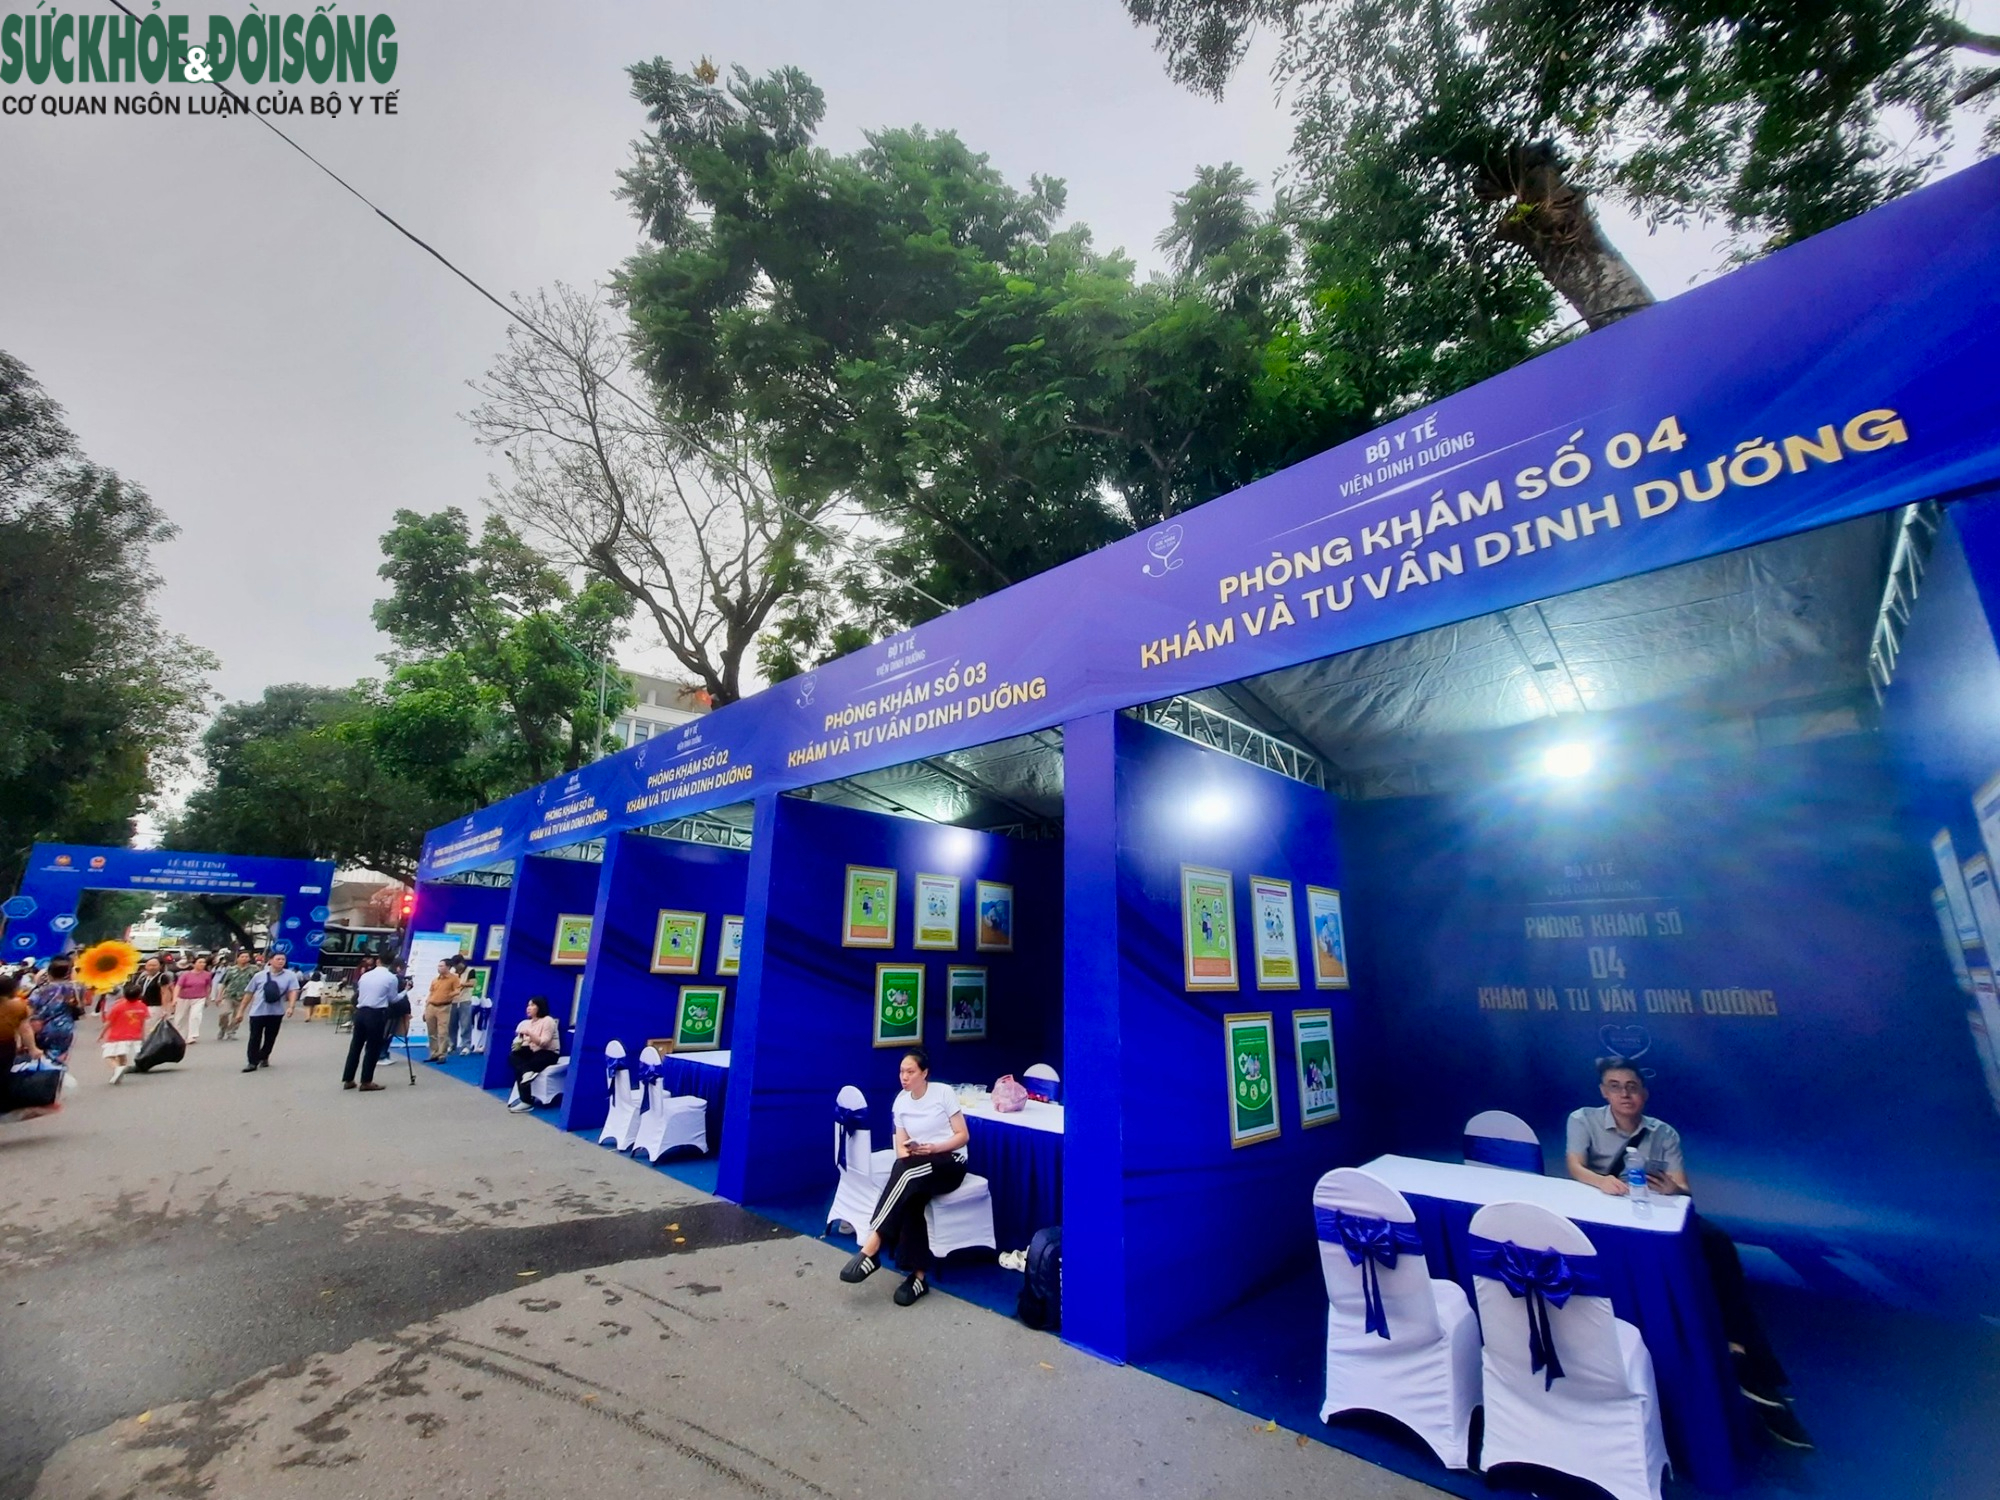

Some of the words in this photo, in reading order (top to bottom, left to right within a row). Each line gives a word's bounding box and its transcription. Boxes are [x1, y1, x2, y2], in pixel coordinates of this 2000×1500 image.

[1366, 437, 1391, 464] BỘ
[1394, 431, 1407, 451] Y
[1411, 411, 1438, 444] TẾ
[1339, 472, 1374, 498] VIỆN
[1377, 454, 1415, 484] DINH
[1418, 431, 1476, 467] DƯỠNG
[1219, 537, 1353, 604] PHÒNG
[1361, 479, 1505, 556] KHÁM
[1515, 428, 1592, 501] SỐ
[1605, 415, 1687, 469] 04
[1140, 617, 1235, 669] KHÁM
[1241, 594, 1295, 637] VÀ
[1301, 576, 1355, 619] TƯ
[1361, 536, 1465, 600] VẤN
[1474, 494, 1622, 568] DINH
[1633, 408, 1909, 520] DƯỠNG
[825, 701, 877, 732] PHÒNG
[880, 682, 930, 715] KHÁM
[934, 659, 960, 697] SỐ
[963, 661, 987, 688] 03
[787, 740, 828, 768] KHÁM
[830, 730, 850, 756] VÀ
[853, 726, 875, 750] TƯ
[876, 709, 912, 743] VẤN
[914, 701, 963, 733] DINH
[967, 677, 1046, 719] DƯỠNG
[626, 794, 648, 814] KHÁM
[649, 789, 659, 807] VÀ
[690, 775, 714, 795] DINH
[714, 764, 753, 789] DƯỠNG
[647, 769, 675, 789] PHÒNG
[675, 758, 701, 780] KHÁM
[702, 745, 717, 771] SỐ
[716, 749, 729, 767] 02
[1524, 912, 1584, 939] PHÒNG
[1591, 910, 1648, 938] KHÁM
[1655, 906, 1684, 935] SỐ
[1588, 946, 1627, 980] 04
[1477, 984, 1529, 1010] KHÁM
[1533, 985, 1559, 1011] VÀ
[1598, 984, 1637, 1013] VẤN
[1644, 988, 1694, 1014] DINH
